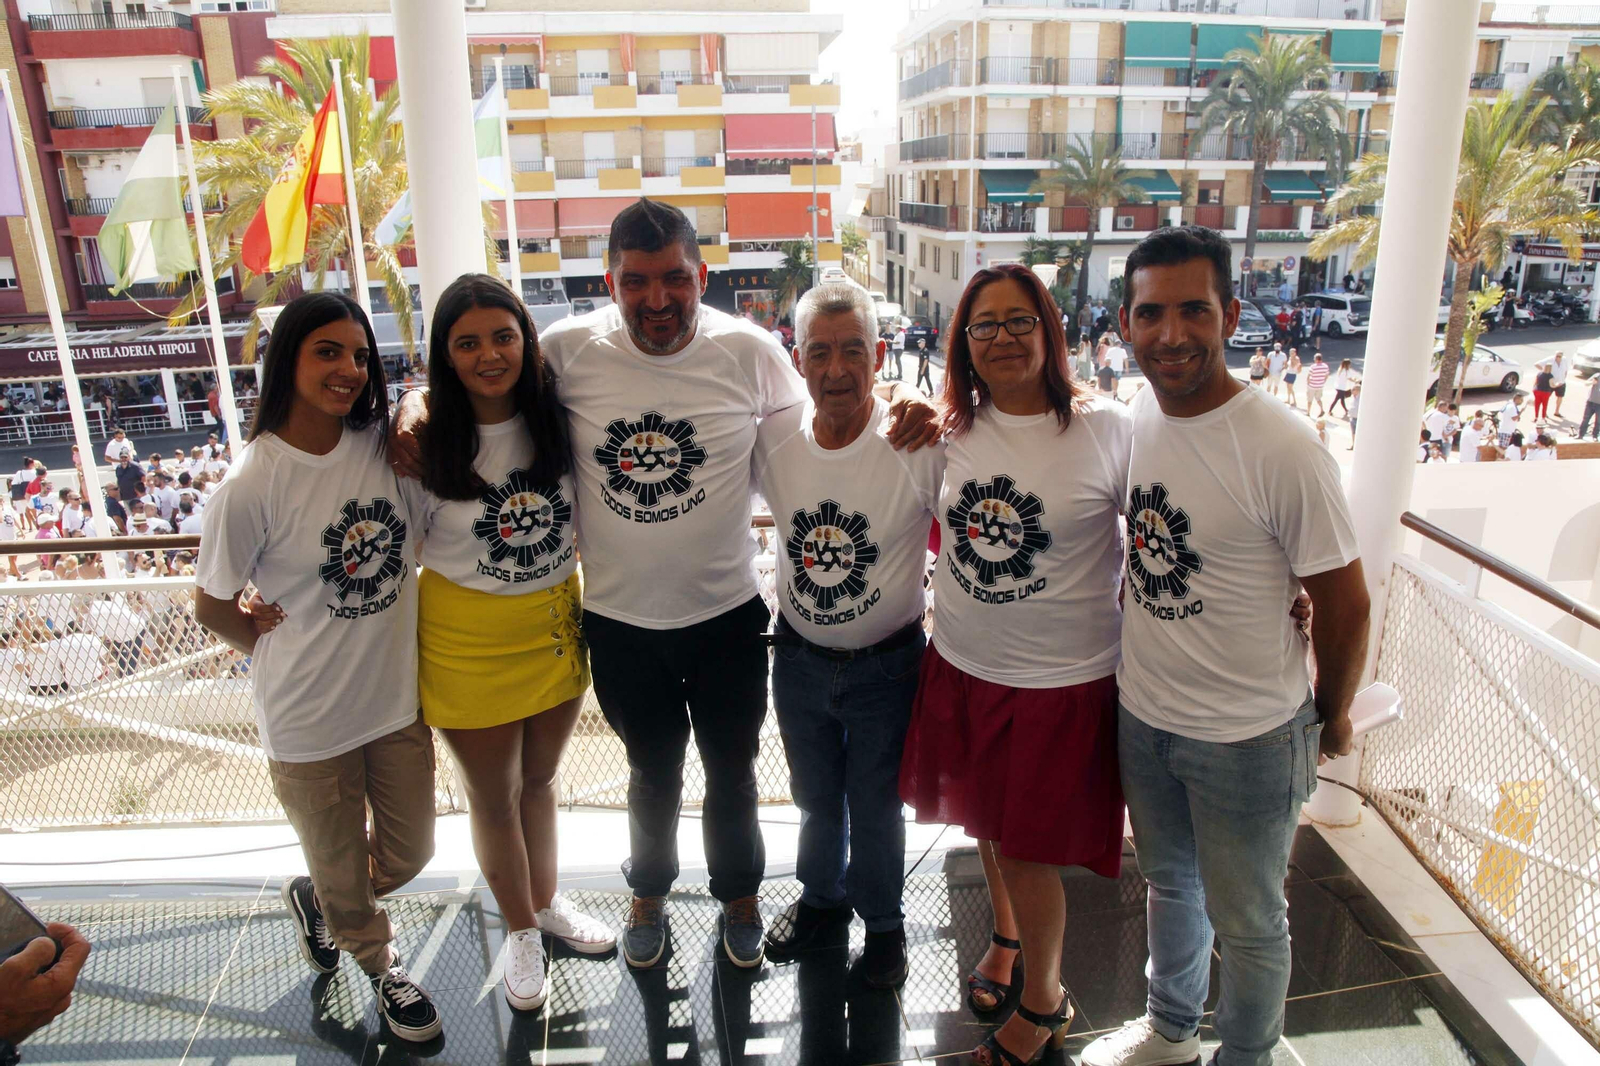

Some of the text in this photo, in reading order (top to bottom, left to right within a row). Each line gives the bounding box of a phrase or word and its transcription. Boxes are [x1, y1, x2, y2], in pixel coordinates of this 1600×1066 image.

[1257, 231, 1306, 241] ARMACIA
[28, 342, 196, 362] CAFERIA HELADERIA HIPOLI
[599, 483, 706, 524] TODOS SOMOS UNO
[513, 563, 551, 583] SOMOS
[552, 545, 573, 571] UNO
[946, 551, 1046, 605] TODOS SOMOS UNO
[360, 588, 398, 617] SOMOS
[787, 580, 881, 626] TODOS SOMOS UNO
[1142, 598, 1203, 621] OMOS UNO
